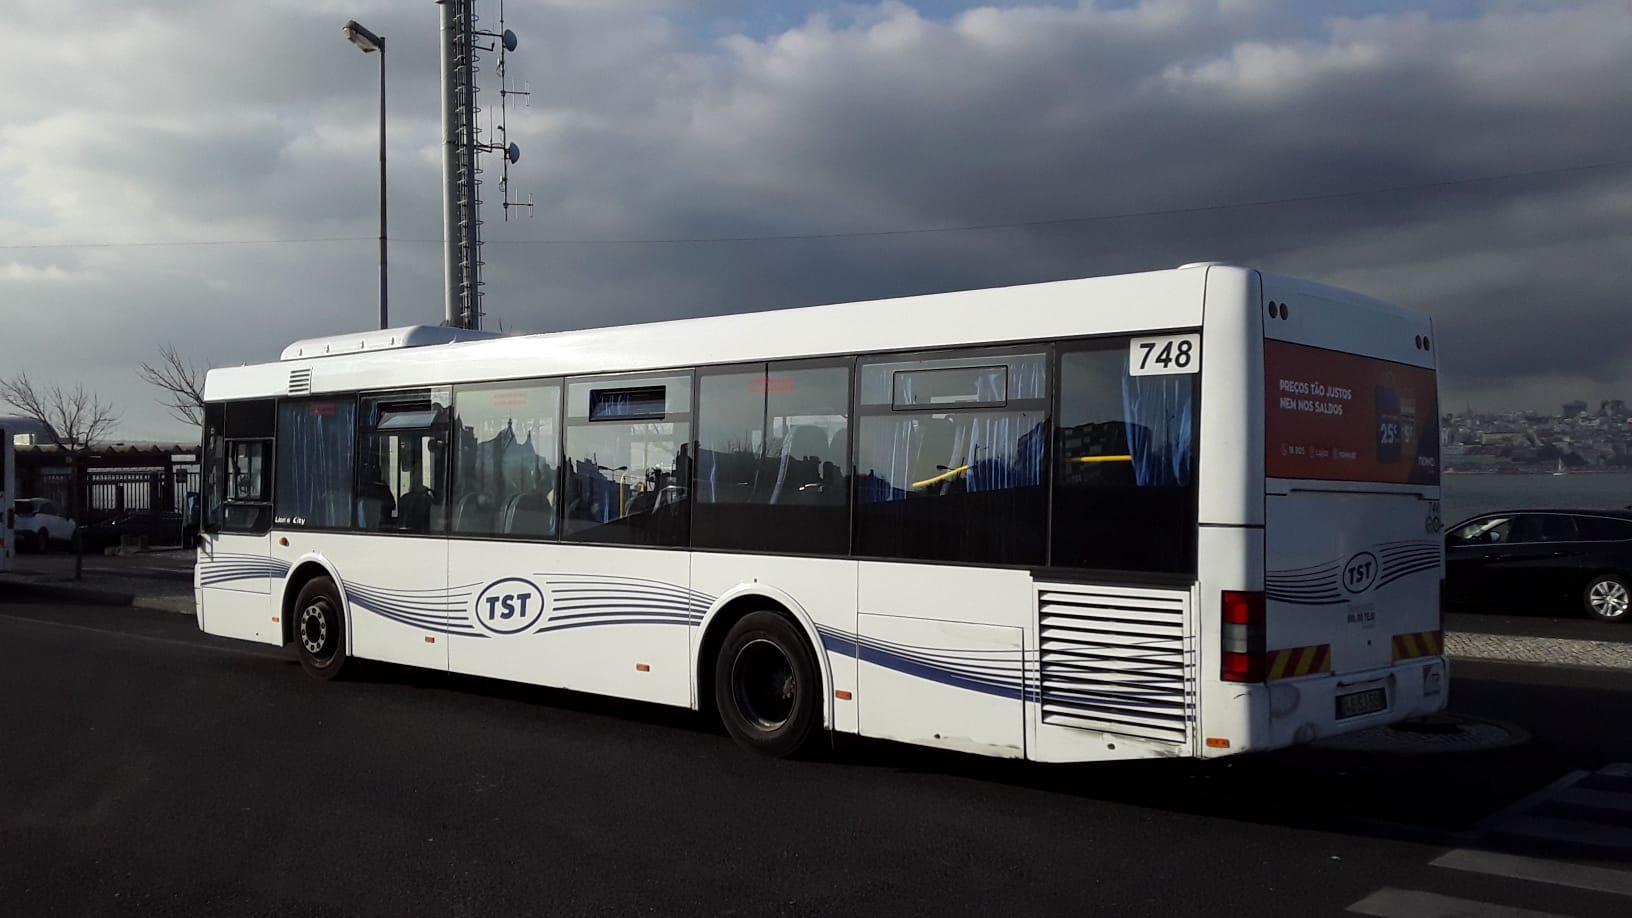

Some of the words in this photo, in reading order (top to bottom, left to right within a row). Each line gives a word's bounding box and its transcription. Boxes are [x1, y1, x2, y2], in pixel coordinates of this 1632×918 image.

[1139, 340, 1193, 369] 748
[1280, 379, 1309, 395] PREÇOS
[1311, 381, 1325, 396] TÃO
[1326, 386, 1352, 400] JUSTOS
[1280, 397, 1297, 410] NEM
[1298, 400, 1314, 412] NOS
[1315, 402, 1343, 415] SALDOS
[274, 515, 291, 523] Lions
[292, 515, 306, 526] City
[1348, 561, 1372, 585] TST
[486, 593, 532, 620] TST
